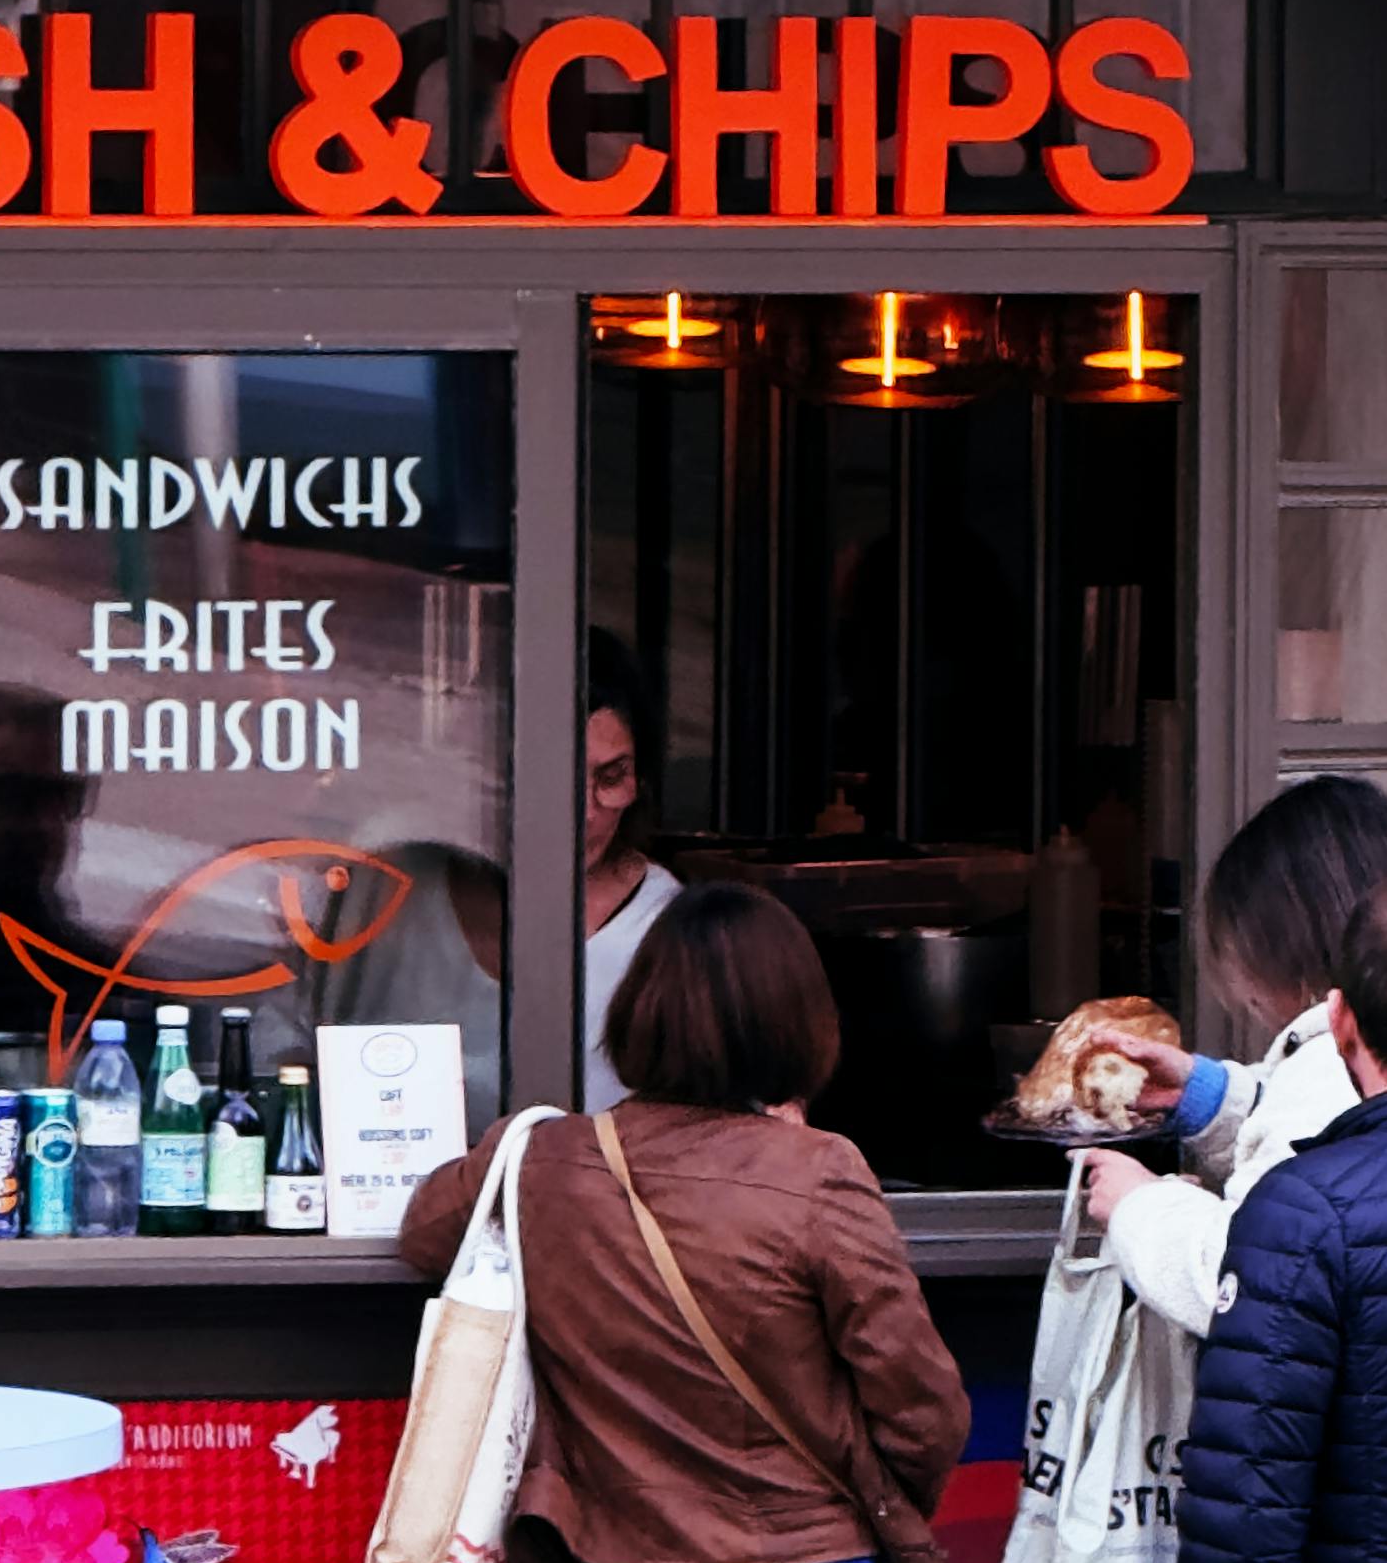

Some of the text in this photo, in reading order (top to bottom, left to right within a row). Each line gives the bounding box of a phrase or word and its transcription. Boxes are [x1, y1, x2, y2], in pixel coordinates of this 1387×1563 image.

[268, 14, 443, 217] &
[504, 16, 1196, 216] CHIPS
[79, 599, 337, 673] FRITES
[61, 697, 360, 774] MAISON
